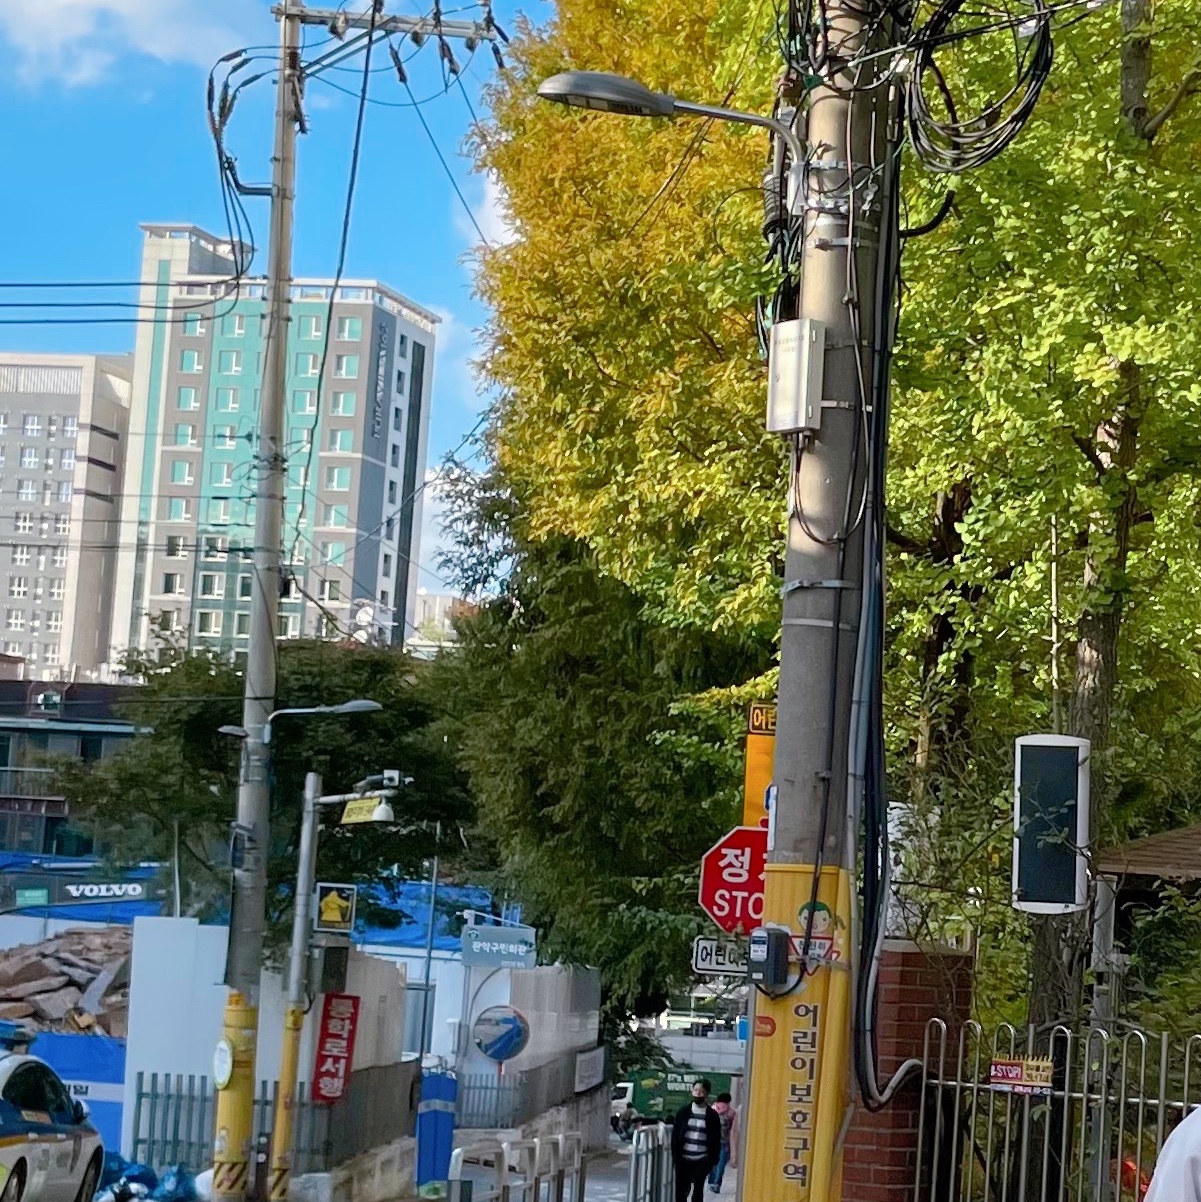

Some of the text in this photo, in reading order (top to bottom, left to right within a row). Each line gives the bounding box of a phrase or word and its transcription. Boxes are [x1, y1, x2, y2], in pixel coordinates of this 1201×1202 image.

[718, 847, 766, 885] 정
[65, 883, 142, 897] VOLVO
[783, 1003, 819, 1188] 어린이보호구역
